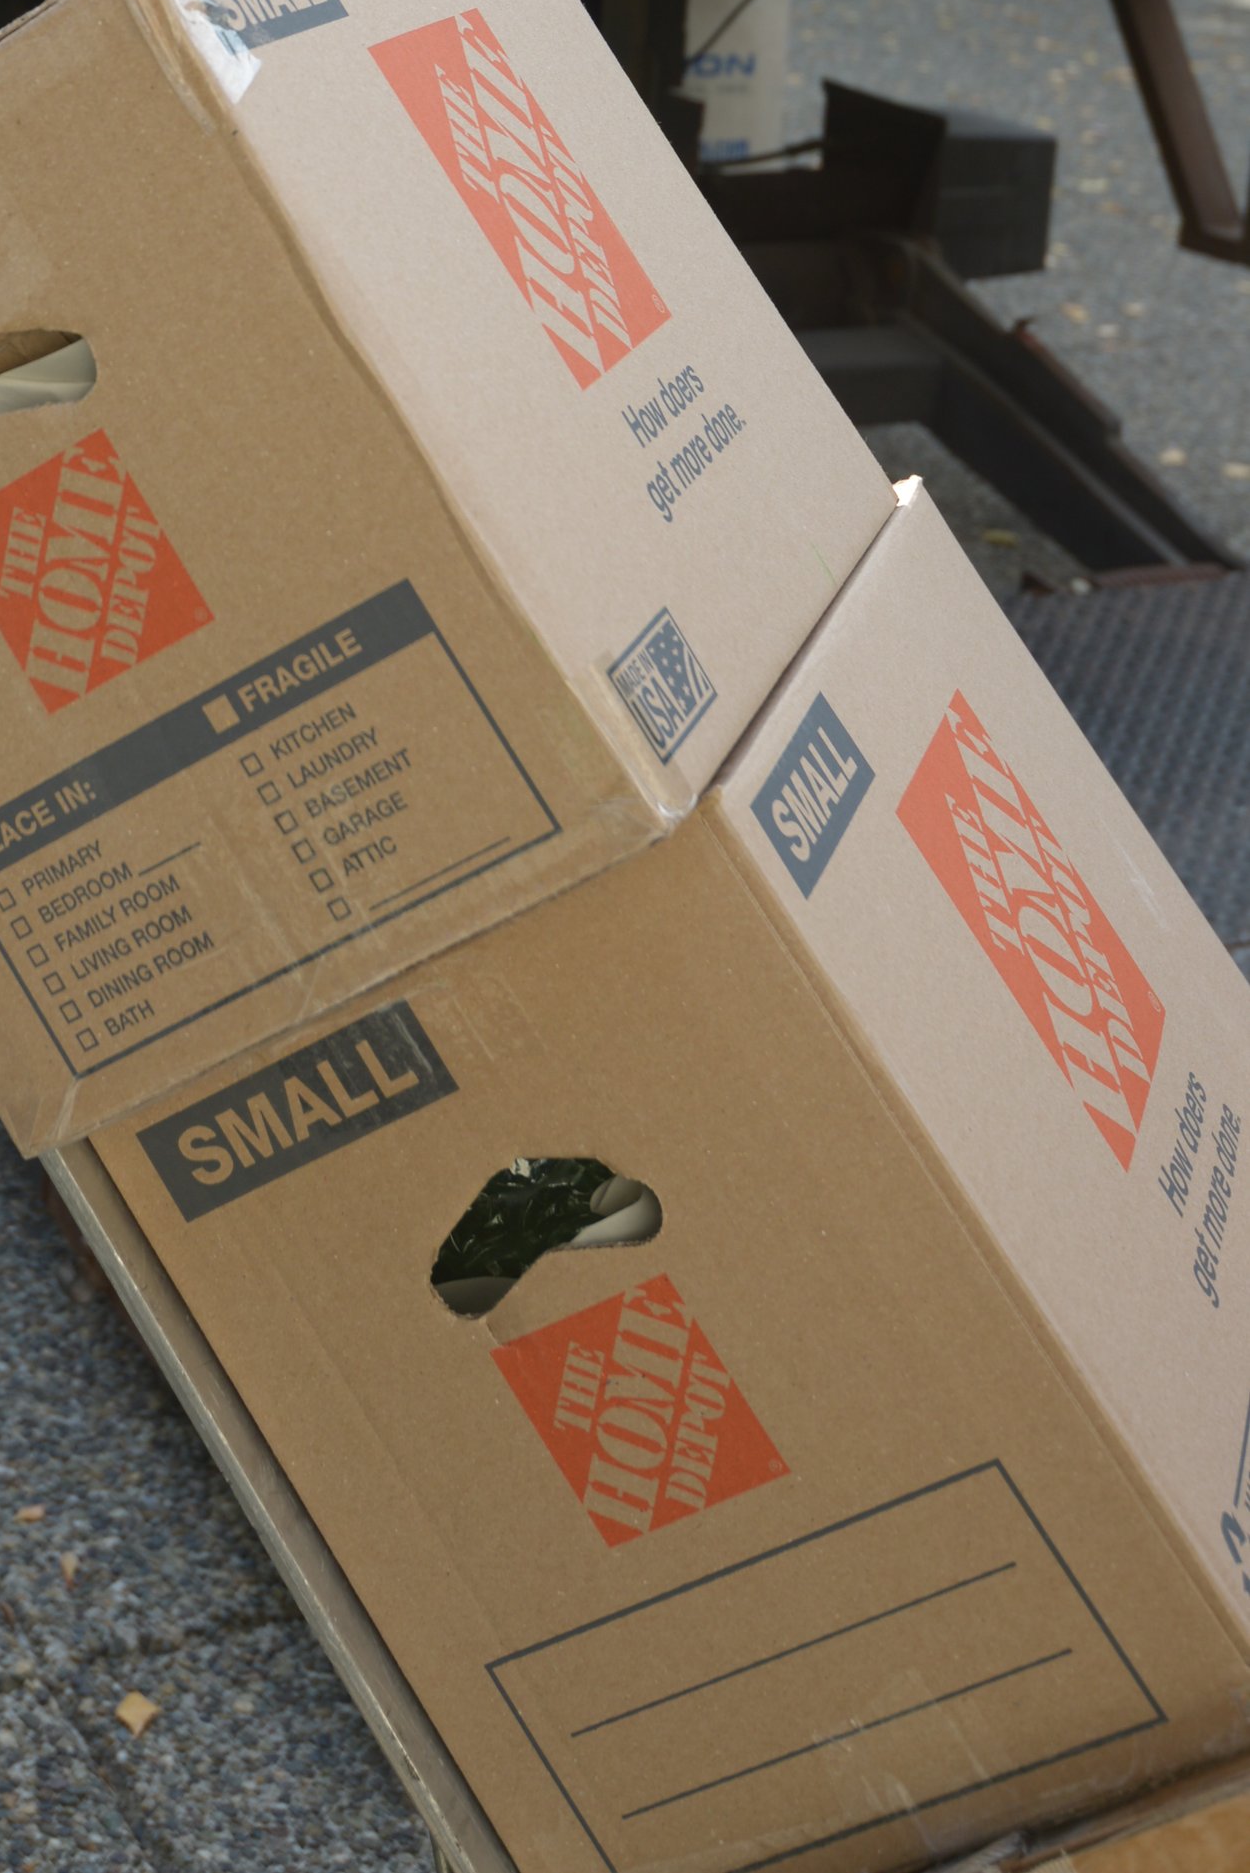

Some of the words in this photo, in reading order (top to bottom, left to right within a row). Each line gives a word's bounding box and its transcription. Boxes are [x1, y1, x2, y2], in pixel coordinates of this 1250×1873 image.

[434, 64, 500, 205] THE
[455, 14, 602, 378] HOME
[539, 123, 633, 350] DEPOT
[621, 397, 668, 448] How
[657, 365, 705, 417] doers
[647, 460, 681, 523] get
[669, 434, 713, 489] more
[701, 403, 747, 453] done.
[25, 445, 126, 695] HOME
[101, 505, 161, 666] DEPOT
[54, 780, 97, 815] IN:
[237, 628, 363, 713] FRAGILE
[269, 701, 357, 760] KITCHEN
[631, 676, 685, 750] USA
[287, 726, 379, 789] LAUNDRY
[304, 748, 412, 818] BASEMENT
[771, 726, 858, 863] SMALL
[323, 791, 408, 846] GARAGE
[342, 835, 397, 877] ATTIC
[22, 839, 104, 897] PRIMARY
[38, 862, 133, 924] BEDROOM
[945, 793, 1025, 956] THE
[54, 905, 117, 952] FAMILY
[119, 874, 181, 917] ROOM
[70, 937, 132, 980] LIVING
[131, 904, 192, 948] ROOM
[948, 706, 1139, 1134] HOME
[1029, 815, 1152, 1084] DEPOT
[87, 963, 153, 1009] DINING
[153, 930, 215, 974] ROOM
[104, 1000, 156, 1037] BATH
[177, 1039, 419, 1186] SMALL
[1175, 1071, 1207, 1153] doers
[1212, 1103, 1241, 1177] done.
[1158, 1139, 1194, 1218] How
[1203, 1165, 1232, 1250] more
[1193, 1227, 1220, 1308] get
[553, 1340, 606, 1433] THE
[583, 1287, 692, 1535] HOME
[665, 1351, 731, 1510] DEPOT
